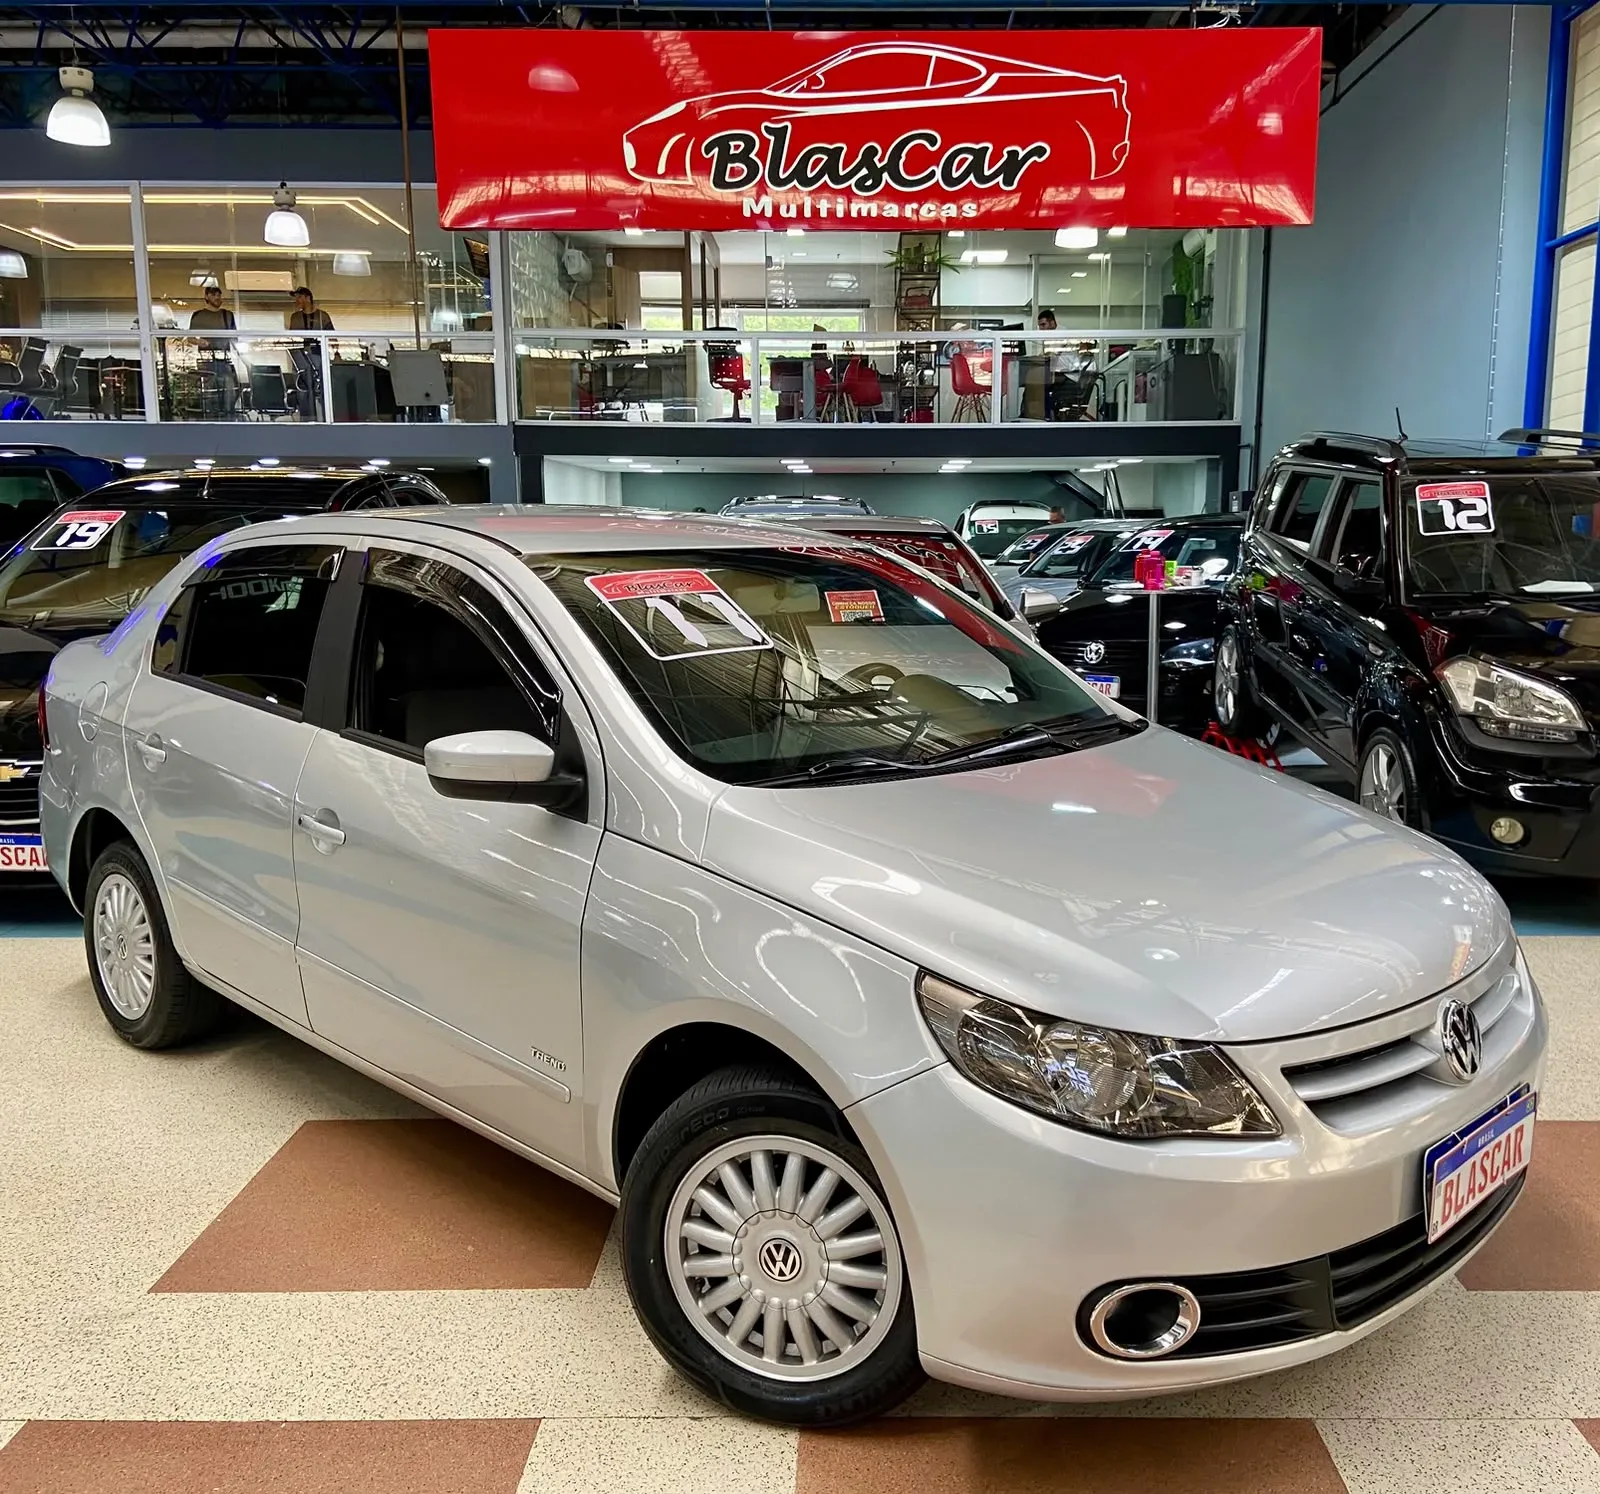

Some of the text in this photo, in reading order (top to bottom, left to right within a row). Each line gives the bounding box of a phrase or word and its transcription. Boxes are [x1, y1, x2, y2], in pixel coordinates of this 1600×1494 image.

[702, 122, 1050, 196] BlasCar
[742, 198, 978, 218] Multimarcas
[1438, 497, 1488, 530] 12
[55, 522, 109, 547] 19
[624, 579, 693, 593] BlasCar
[1442, 1124, 1525, 1225] BLASCAR
